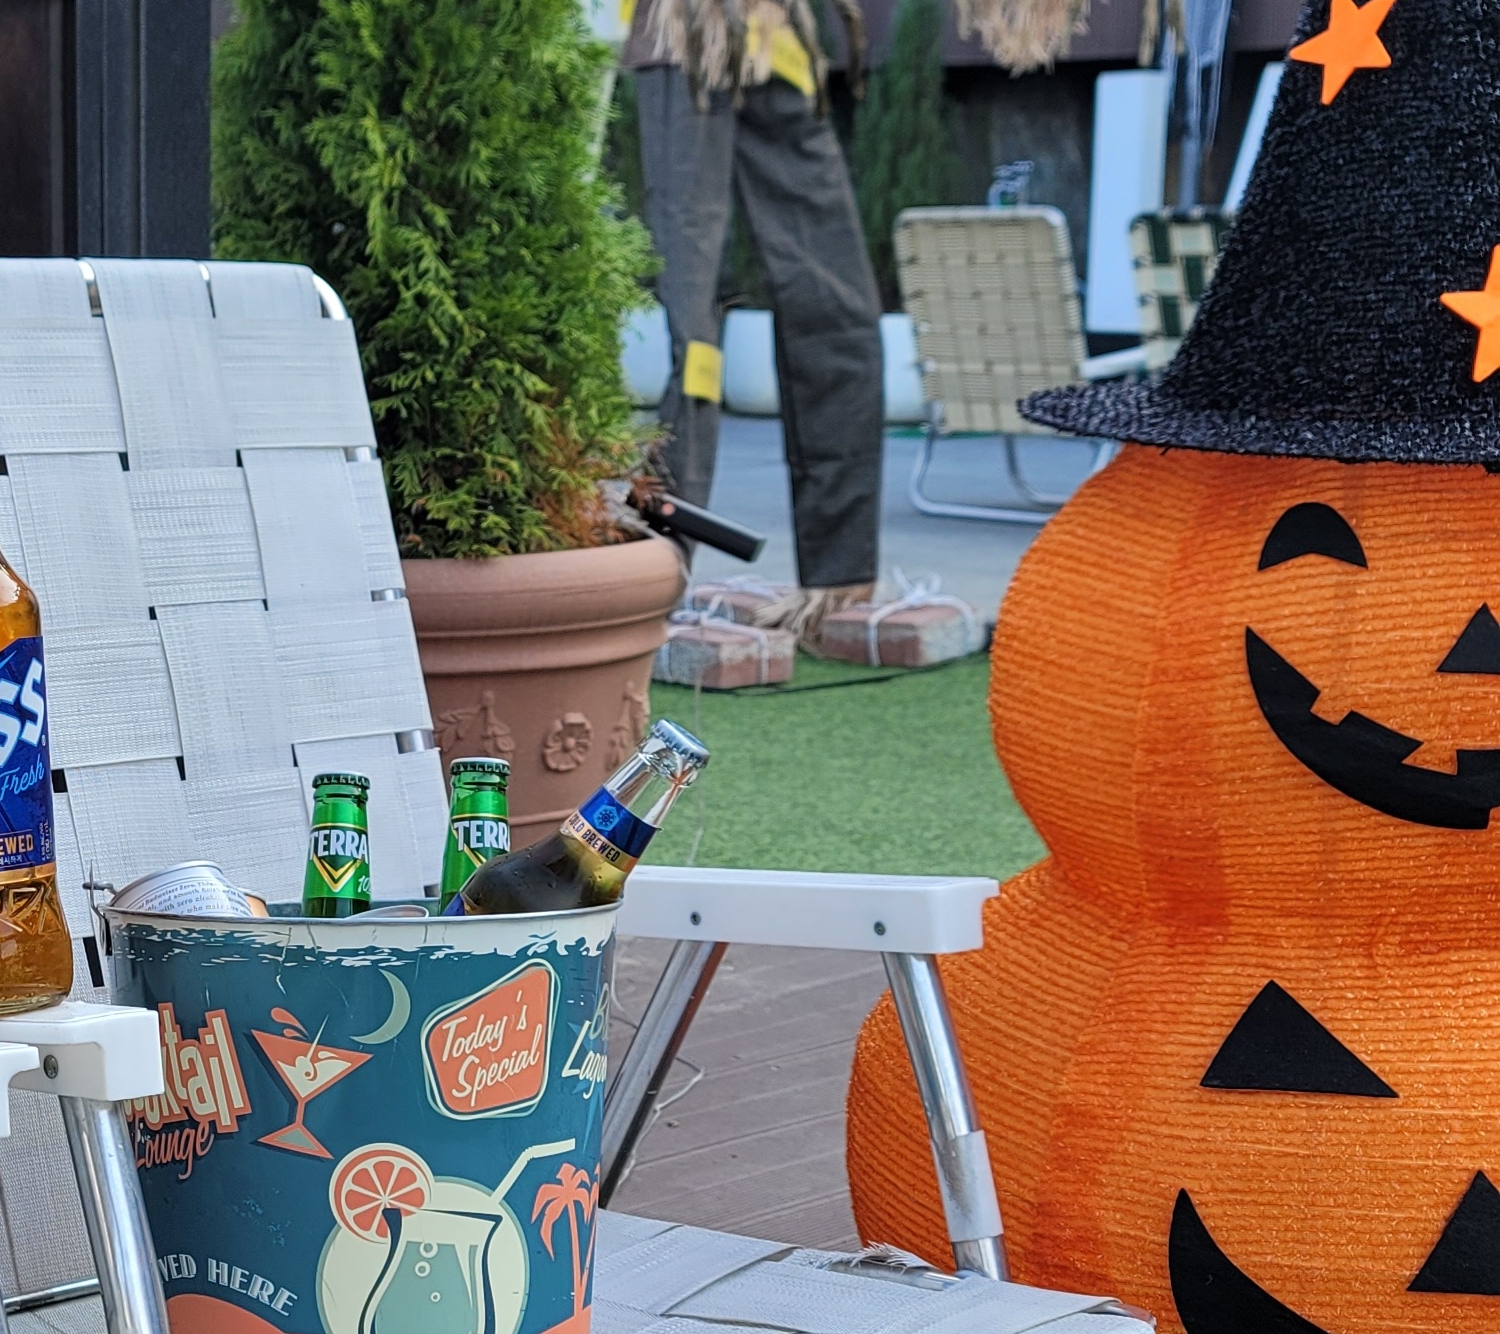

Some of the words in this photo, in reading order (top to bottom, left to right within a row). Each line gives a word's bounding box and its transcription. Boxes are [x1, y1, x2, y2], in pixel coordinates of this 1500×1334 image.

[310, 829, 369, 865] TERRA
[454, 819, 510, 853] TERR
[581, 829, 621, 862] BREWED
[441, 990, 528, 1062] Today's
[451, 1023, 543, 1107] Special
[207, 1257, 299, 1317] HERE
